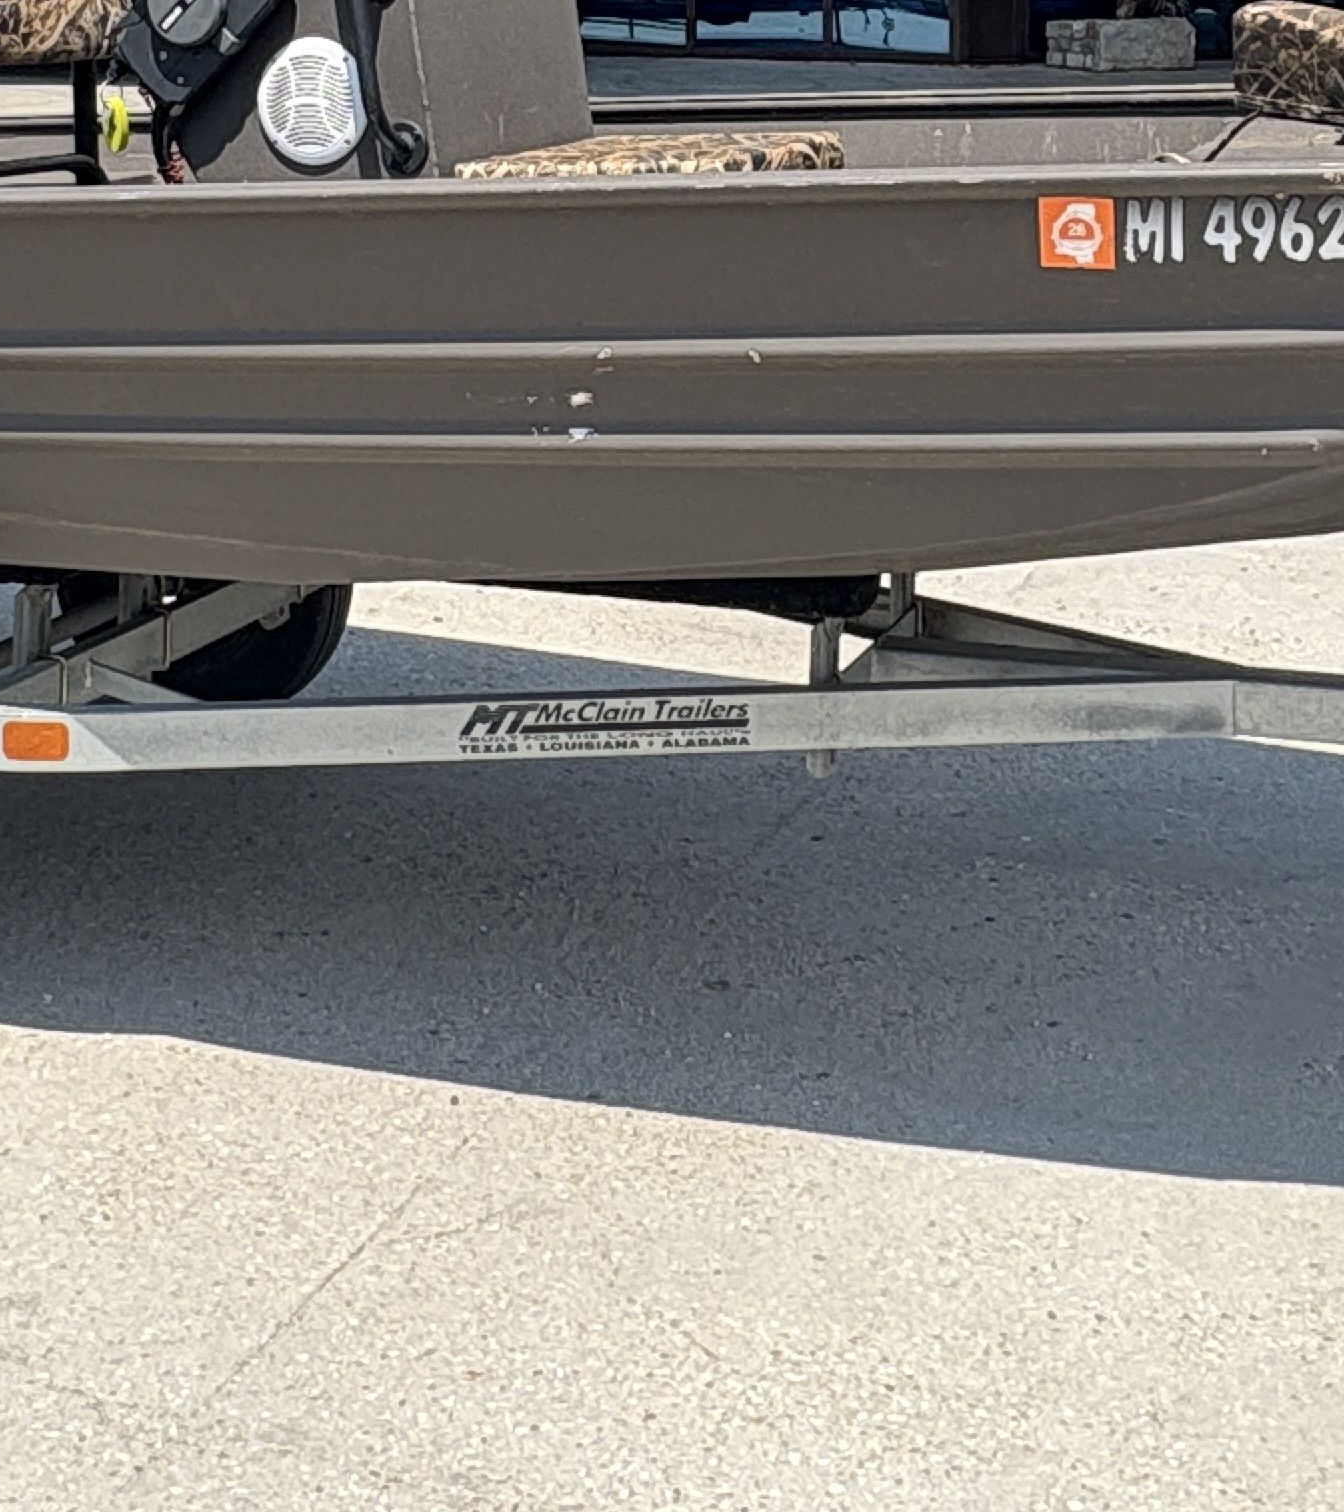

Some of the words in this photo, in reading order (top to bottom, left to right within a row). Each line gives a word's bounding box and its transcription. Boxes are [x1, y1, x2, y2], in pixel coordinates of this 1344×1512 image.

[1124, 196, 1184, 263] MI
[535, 700, 646, 724] McClain
[655, 698, 750, 720] Trailers
[459, 743, 518, 753] TEXAS
[539, 739, 641, 752] LOUISIANA
[662, 736, 751, 749] ALABAMA
